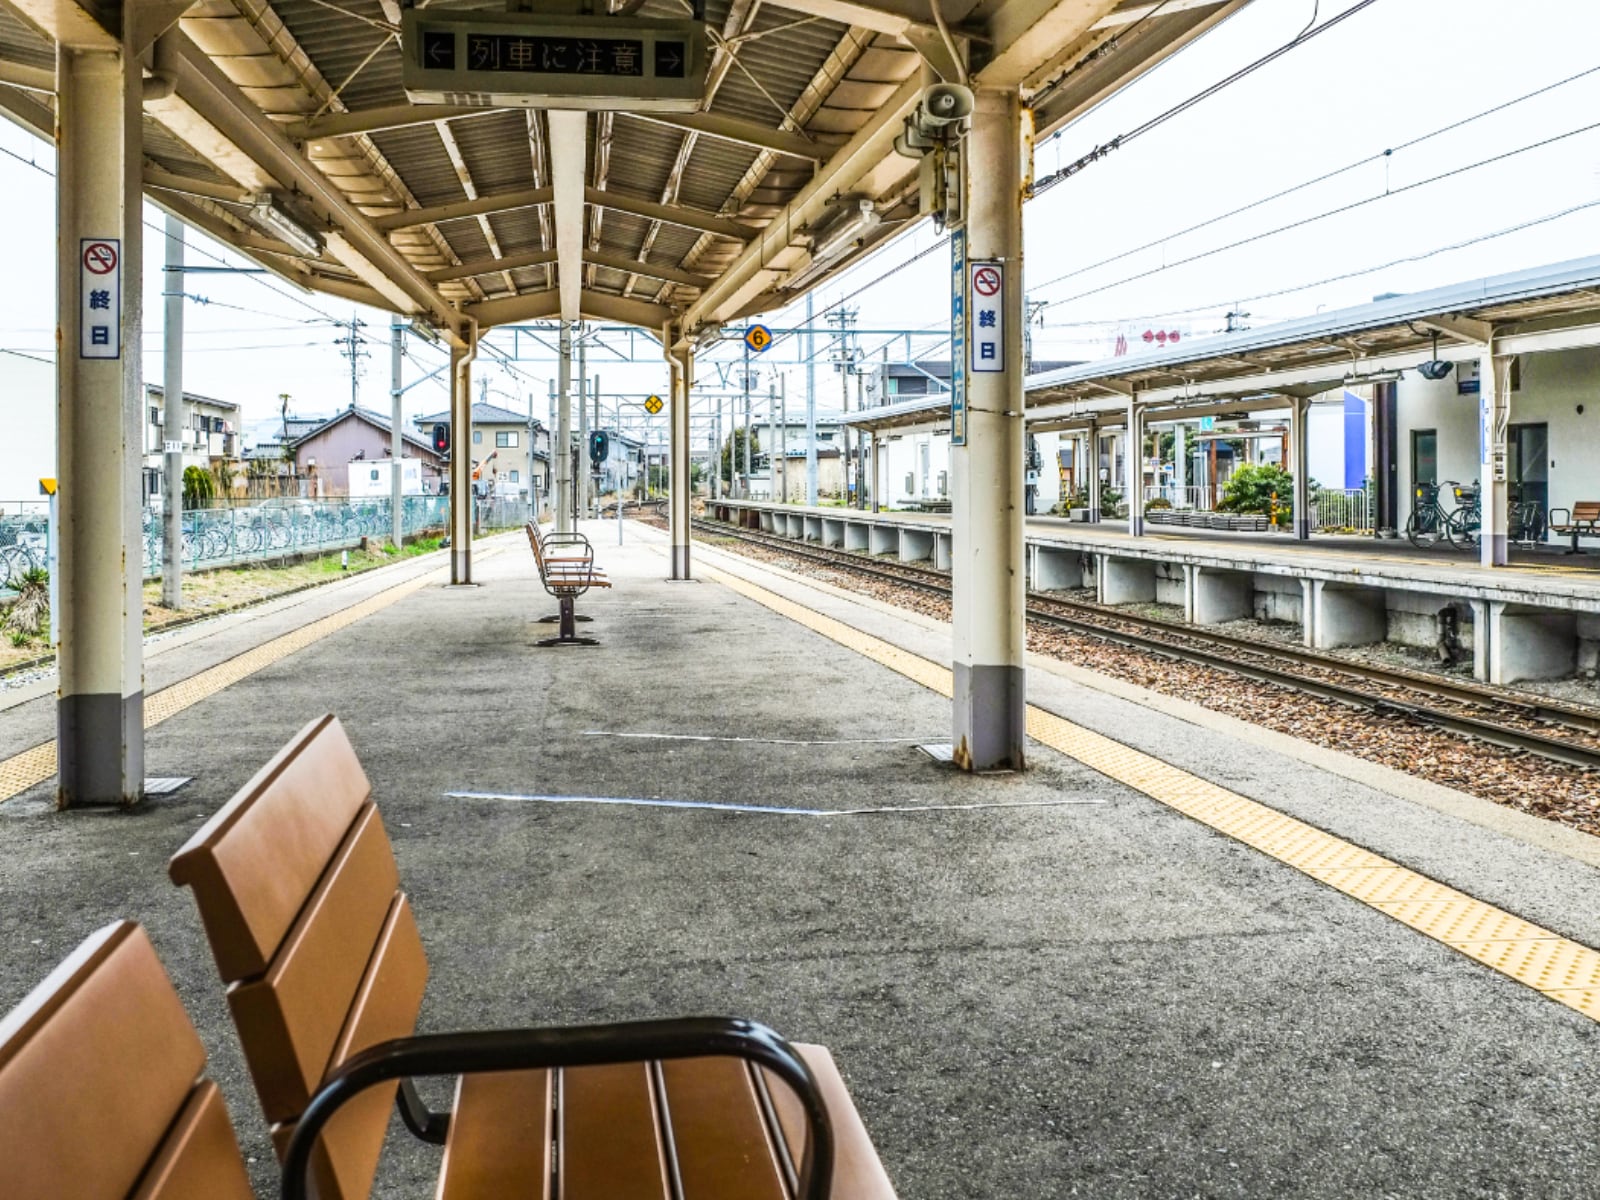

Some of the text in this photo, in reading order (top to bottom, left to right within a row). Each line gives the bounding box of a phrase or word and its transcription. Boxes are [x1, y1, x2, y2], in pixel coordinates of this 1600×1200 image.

[471, 37, 640, 74] 列車に注意
[89, 289, 111, 345] 終日
[752, 330, 764, 346] 6
[978, 309, 996, 360] 終日
